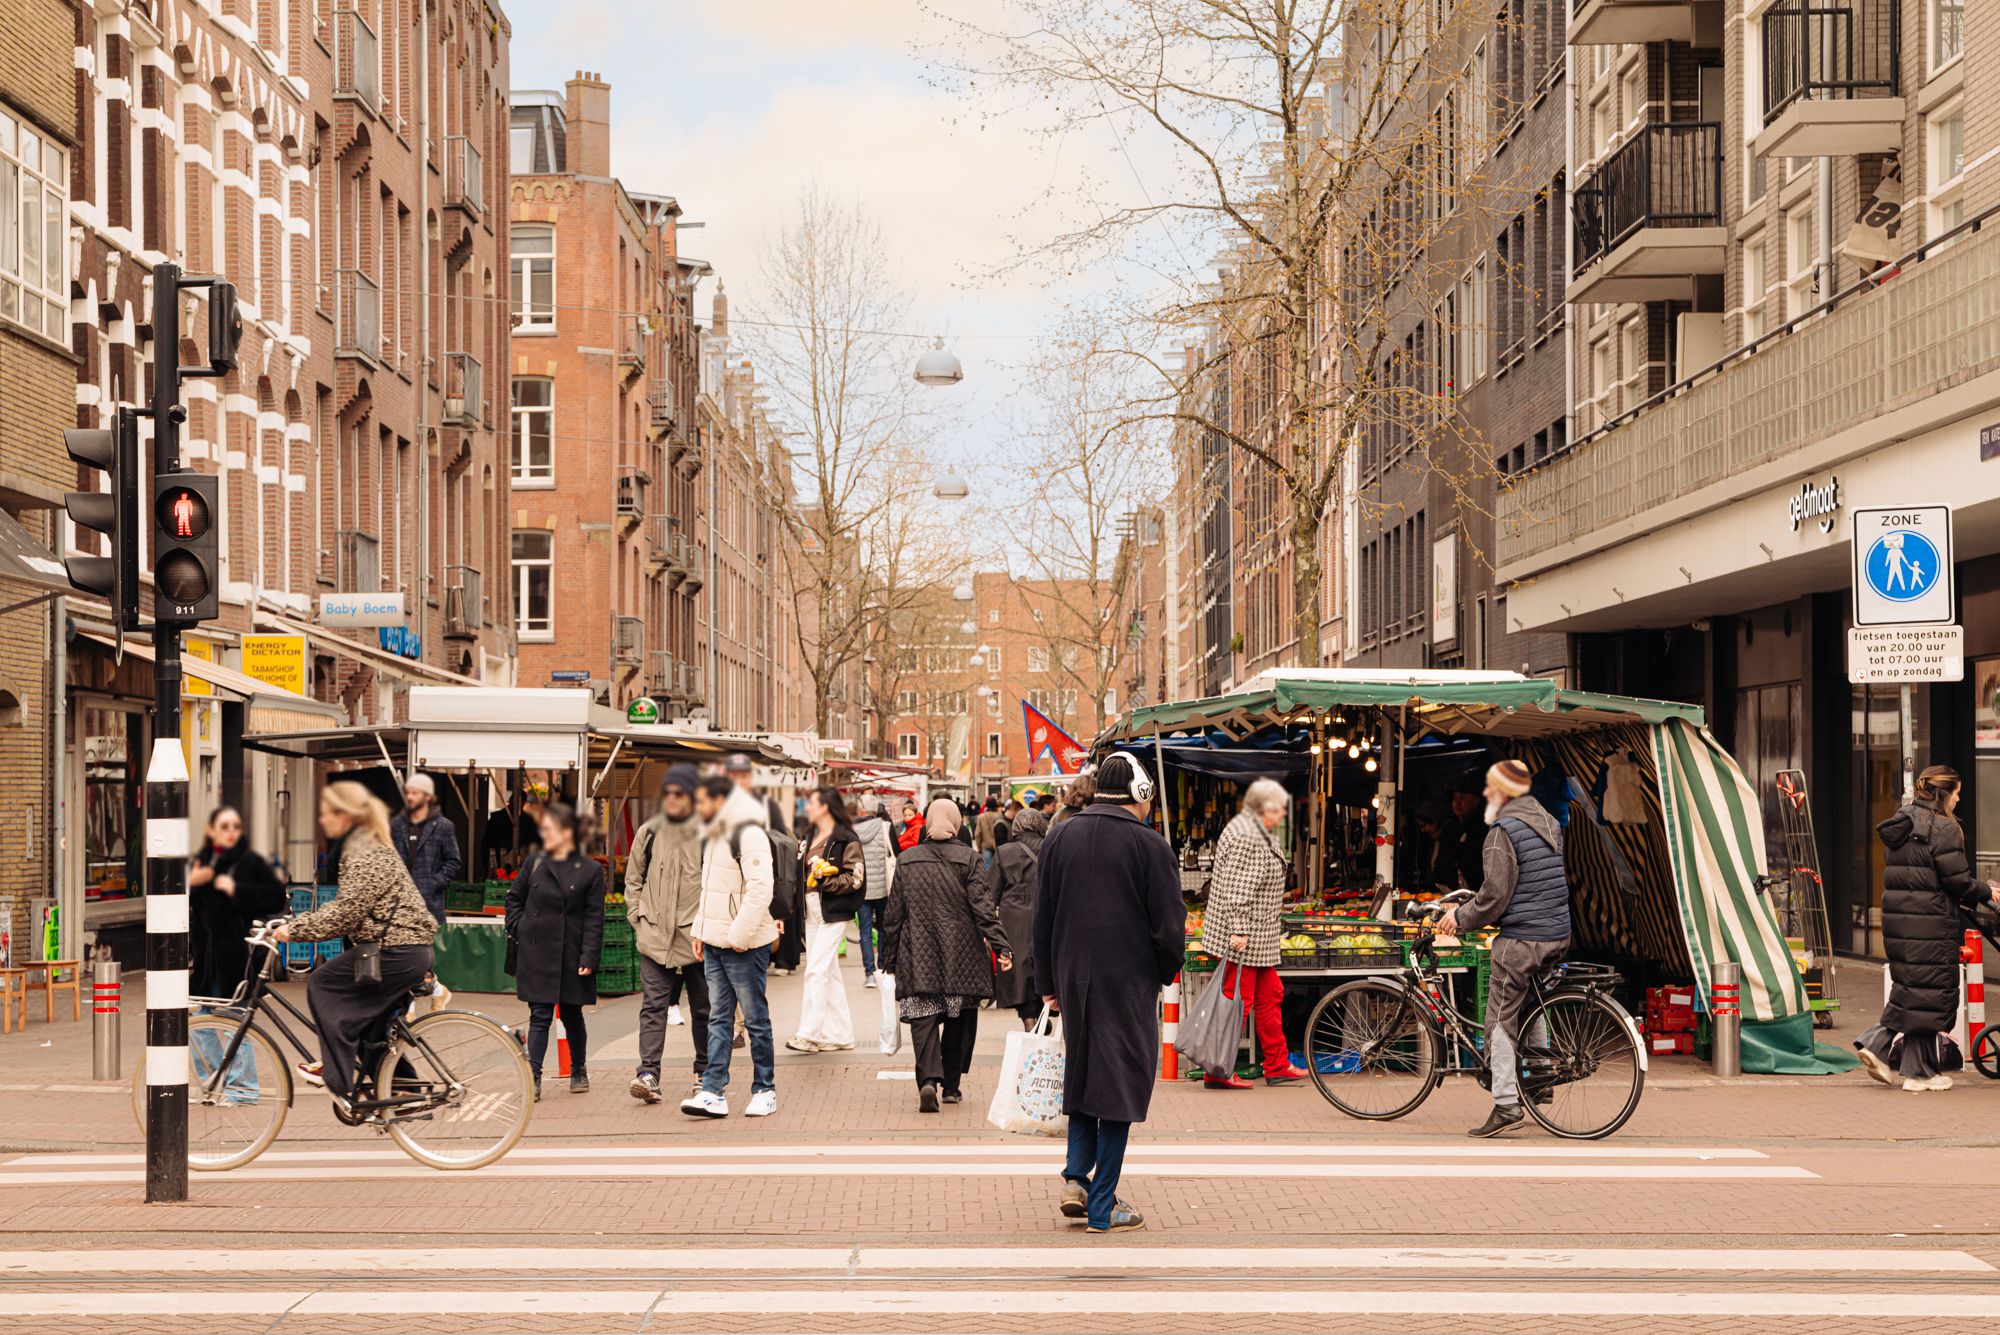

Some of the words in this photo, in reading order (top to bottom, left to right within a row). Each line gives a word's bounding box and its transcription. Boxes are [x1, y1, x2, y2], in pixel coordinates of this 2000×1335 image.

[1881, 514, 1922, 526] ZONE
[175, 606, 195, 615] 911
[326, 603, 357, 617] Baby
[364, 602, 397, 614] Boem
[1854, 632, 1893, 641] fietsen
[1896, 630, 1957, 641] toegestaan
[1890, 643, 1923, 652] 20.00
[1926, 643, 1946, 651] uur
[1869, 657, 1885, 665] tot
[1888, 655, 1921, 664] 07.00
[1924, 655, 1944, 663] uur
[251, 665, 296, 673] TABAKSHOP
[1887, 669, 1900, 678] op
[1903, 667, 1943, 677] zondag
[266, 674, 286, 682] HOME
[288, 674, 298, 682] OF
[1031, 1078, 1065, 1090] ACTION
